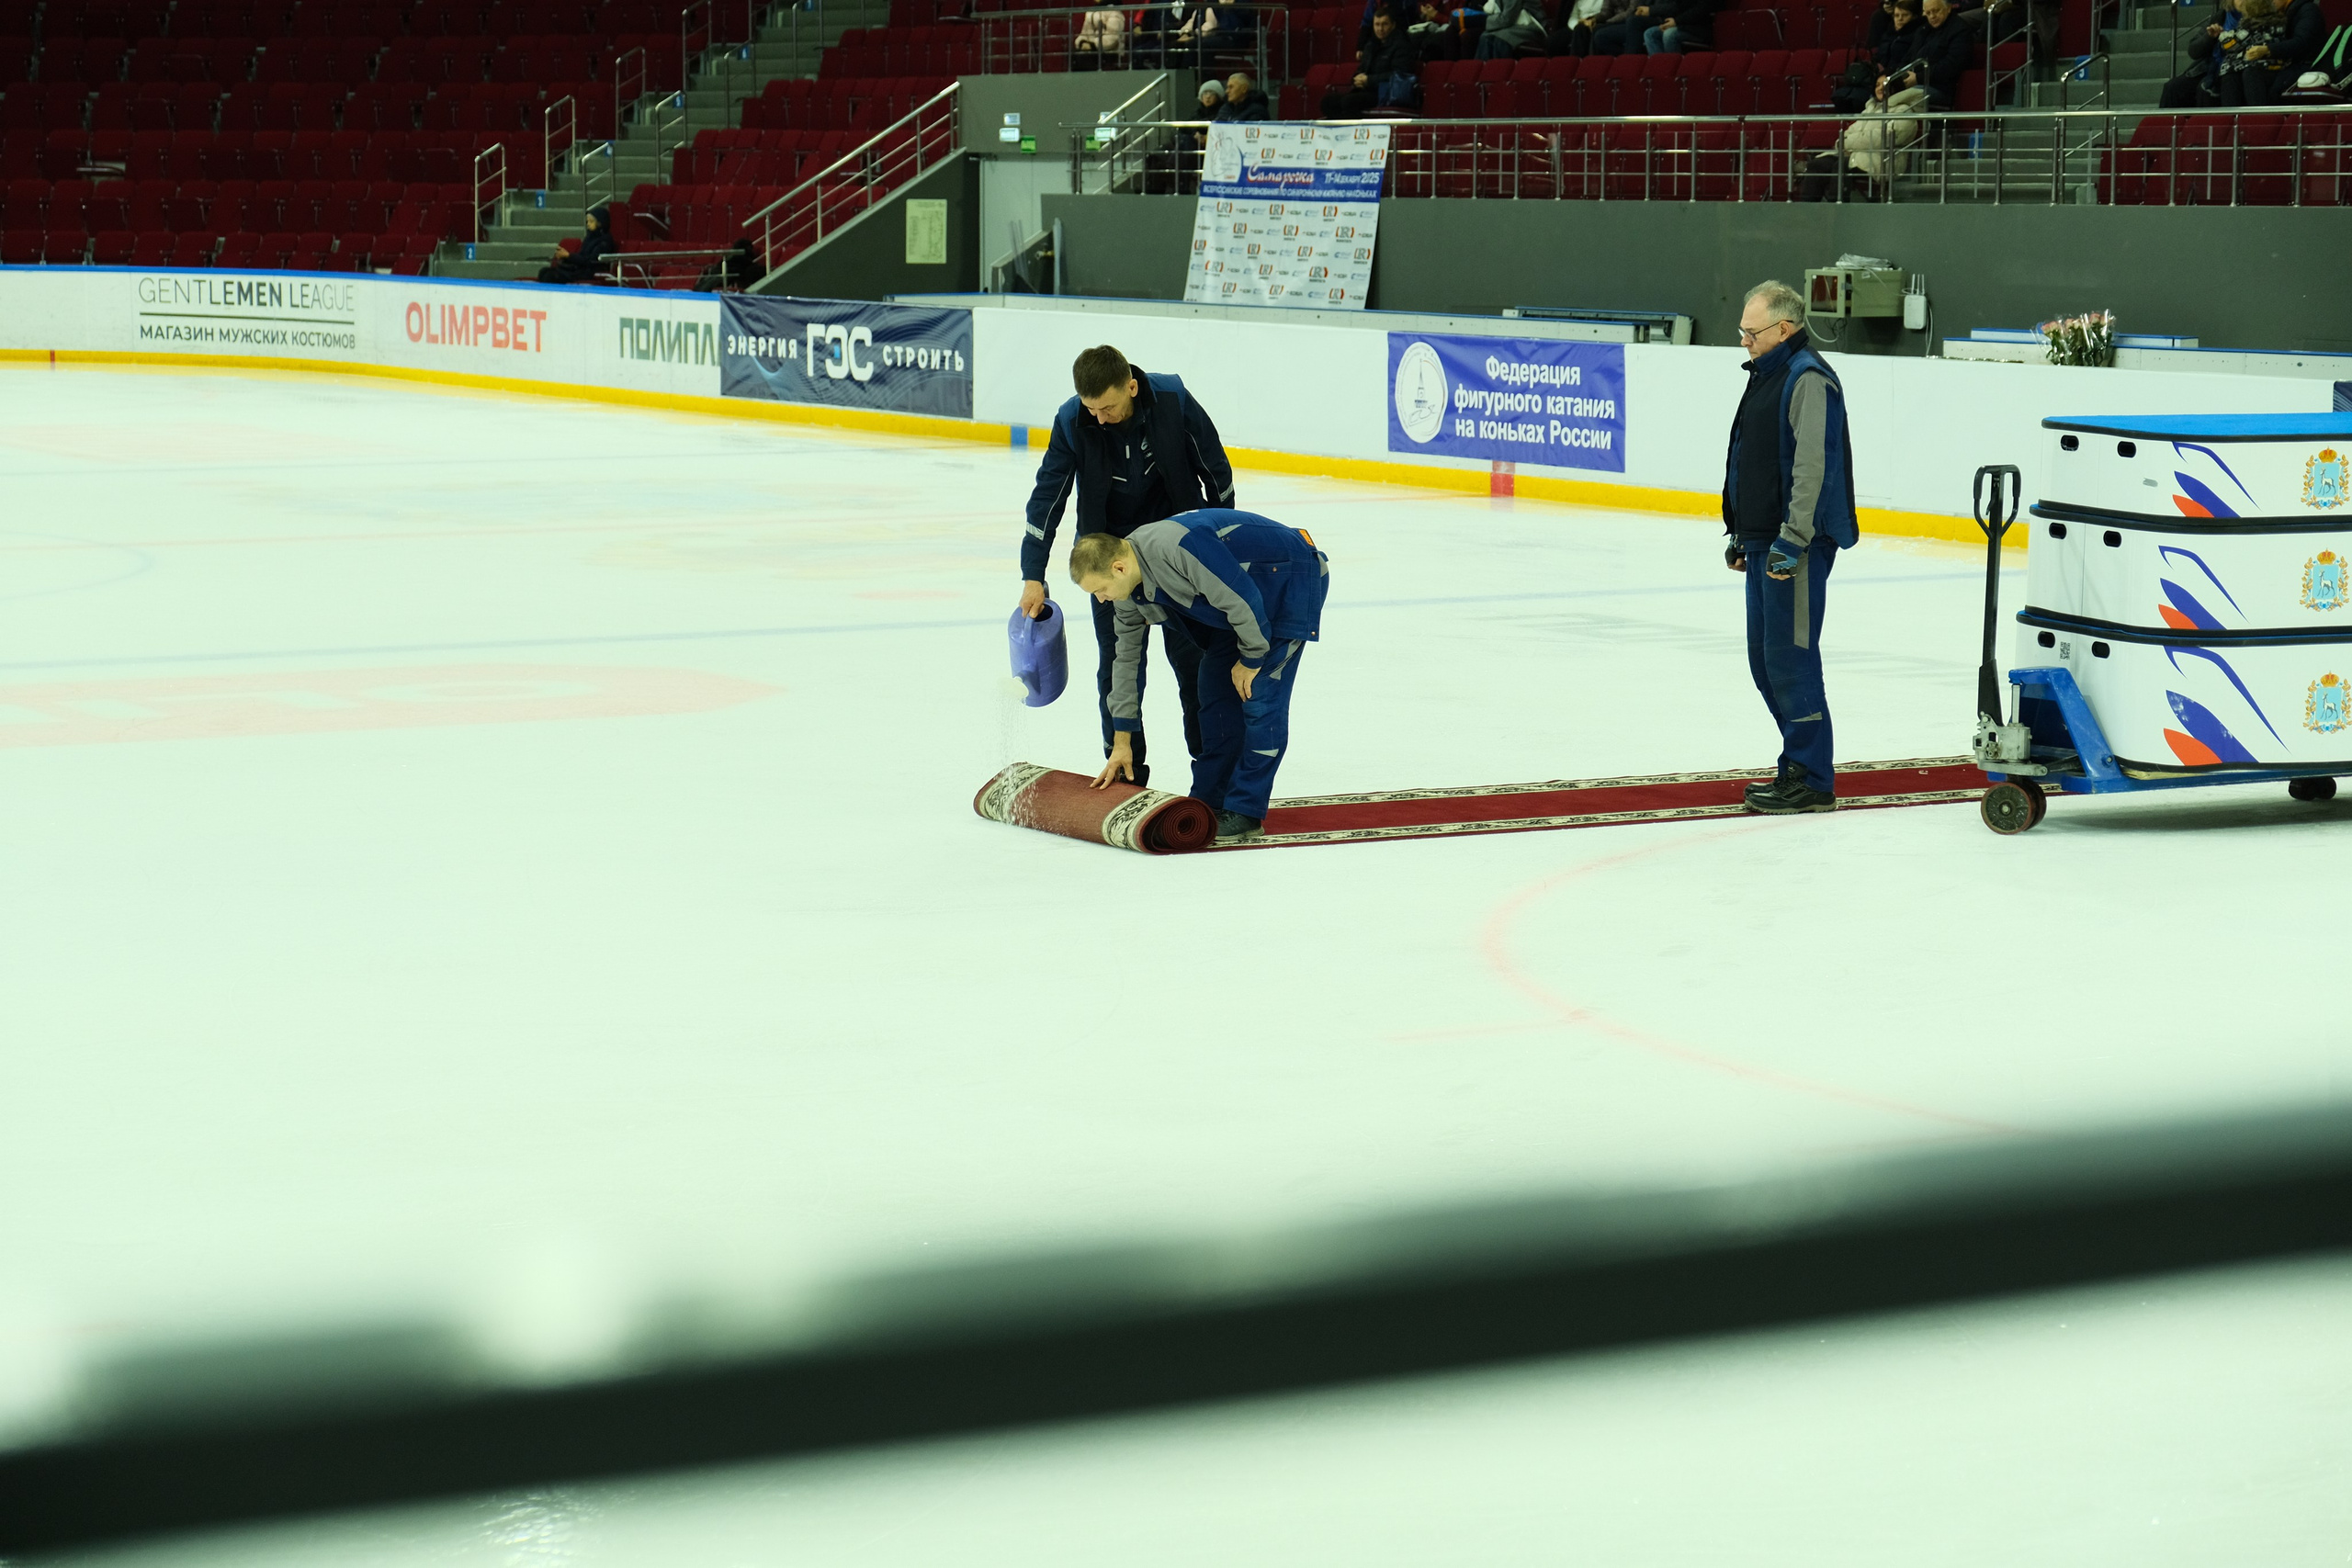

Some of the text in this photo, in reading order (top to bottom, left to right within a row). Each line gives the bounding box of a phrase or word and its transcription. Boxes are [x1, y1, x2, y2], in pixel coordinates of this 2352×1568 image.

[139, 277, 355, 311] GENTLEMEN LEAGUE
[140, 324, 356, 349] МАГАЗИН МУЖСКИХ КОСТЮМОВ
[405, 301, 547, 353] OLIMPBET
[619, 317, 720, 367] ПОЛИПЛ
[728, 334, 797, 359] ЭНЕРГИЯ
[807, 323, 873, 381] ГЭС
[883, 344, 965, 371] СТРОИТЬ
[1486, 355, 1580, 389] Федерация
[1454, 383, 1615, 419] фигурного катания
[1455, 418, 1611, 450] на коньках России
